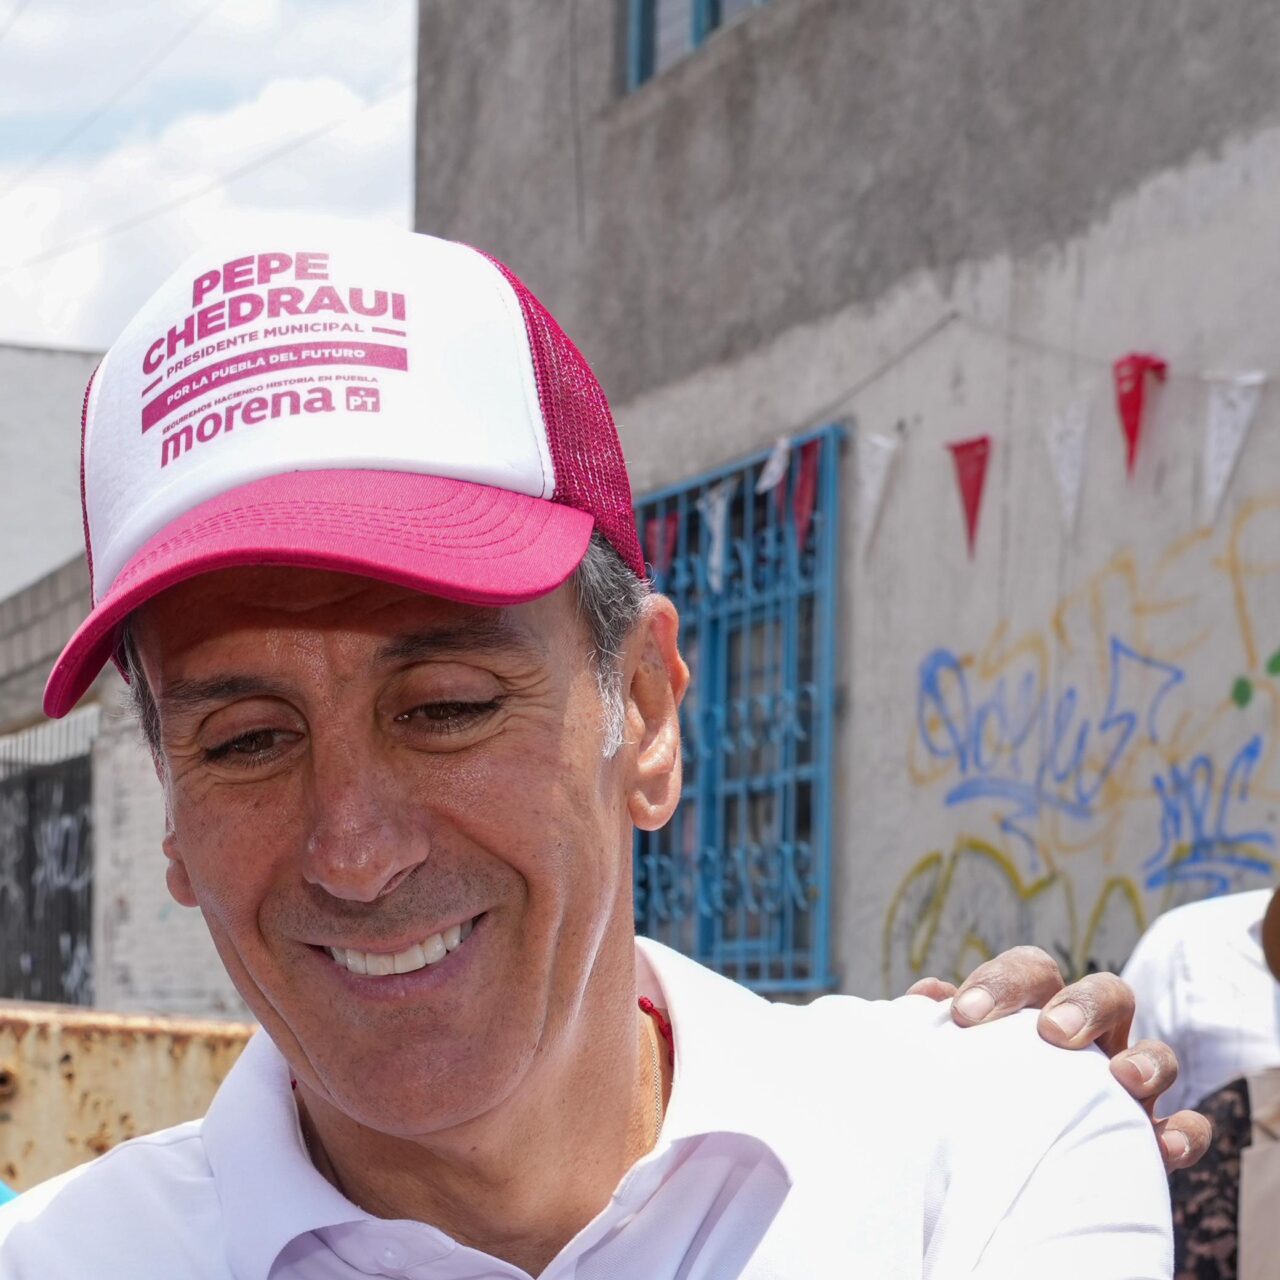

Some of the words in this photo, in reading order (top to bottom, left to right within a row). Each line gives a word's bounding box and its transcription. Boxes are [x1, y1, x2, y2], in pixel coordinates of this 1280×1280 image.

[192, 252, 329, 308] PEPE
[142, 286, 406, 375] CHEDRAUI
[167, 331, 259, 379] PRESIDENTE
[263, 323, 365, 338] MUNICIPAL
[162, 402, 212, 435] SEGUIREMOS
[214, 386, 264, 406] HACIENDO
[266, 376, 315, 390] HISTORIA
[335, 375, 378, 383] PUEBLA
[167, 385, 190, 406] POR
[192, 376, 209, 390] LA
[211, 358, 266, 382] PUEBLA
[269, 352, 298, 364] DEL
[301, 349, 366, 359] FUTURO
[161, 387, 336, 468] morena
[349, 396, 377, 410] PT
